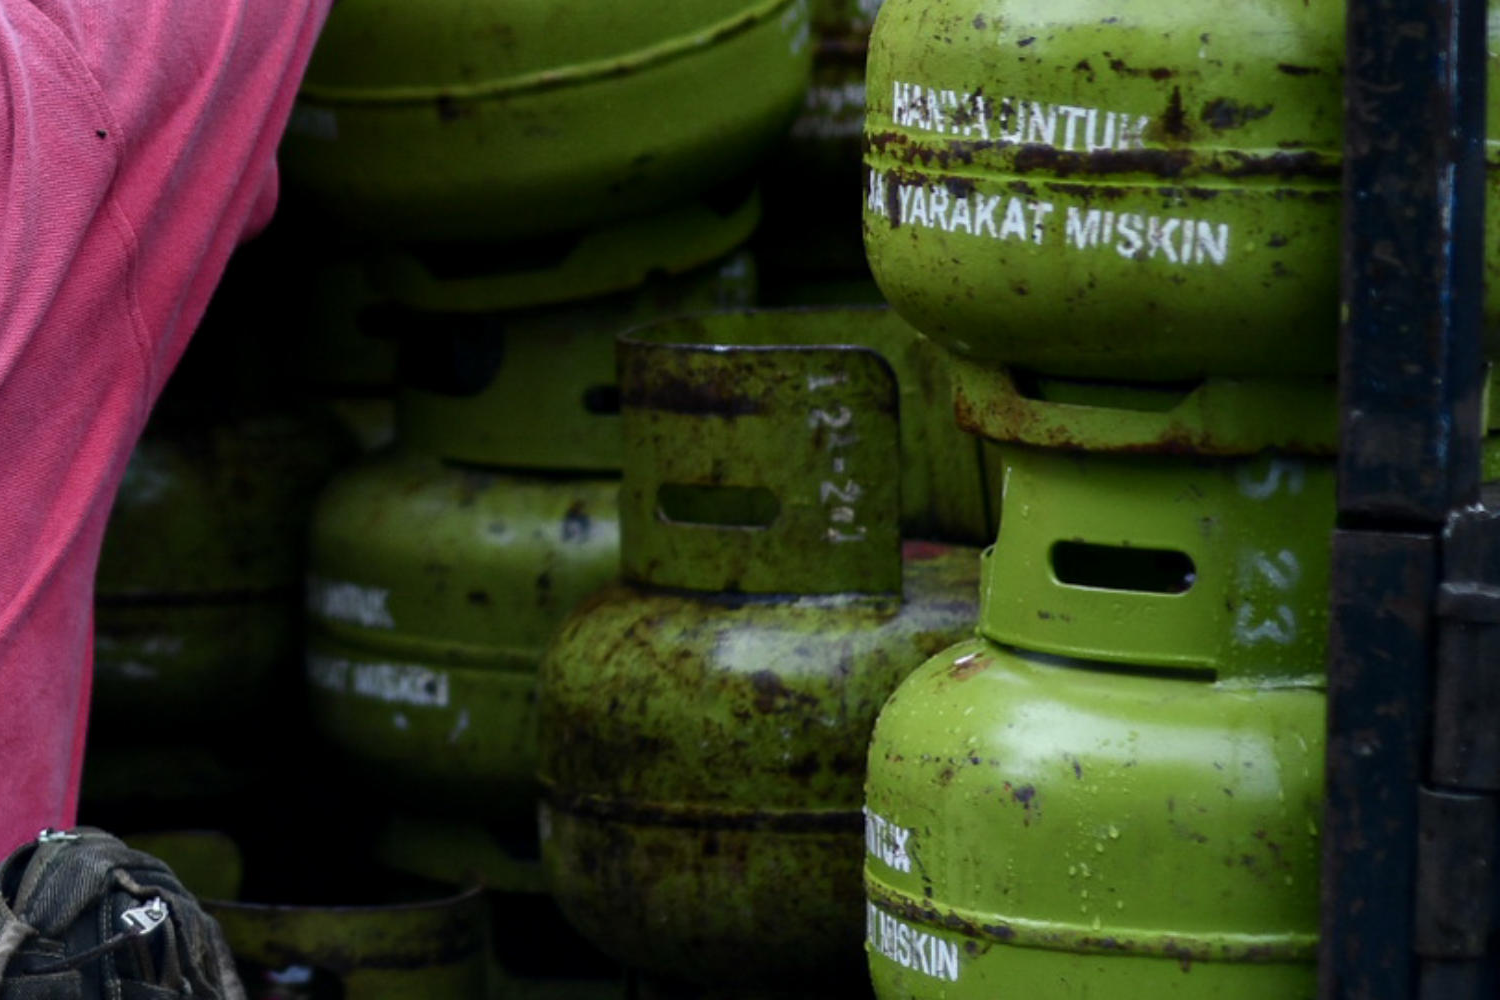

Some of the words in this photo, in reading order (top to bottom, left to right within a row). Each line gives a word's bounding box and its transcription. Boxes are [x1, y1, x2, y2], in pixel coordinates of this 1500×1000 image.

[893, 80, 989, 140] HANYA
[1001, 96, 1150, 153] UNTUK
[1066, 206, 1228, 266] MISKIN
